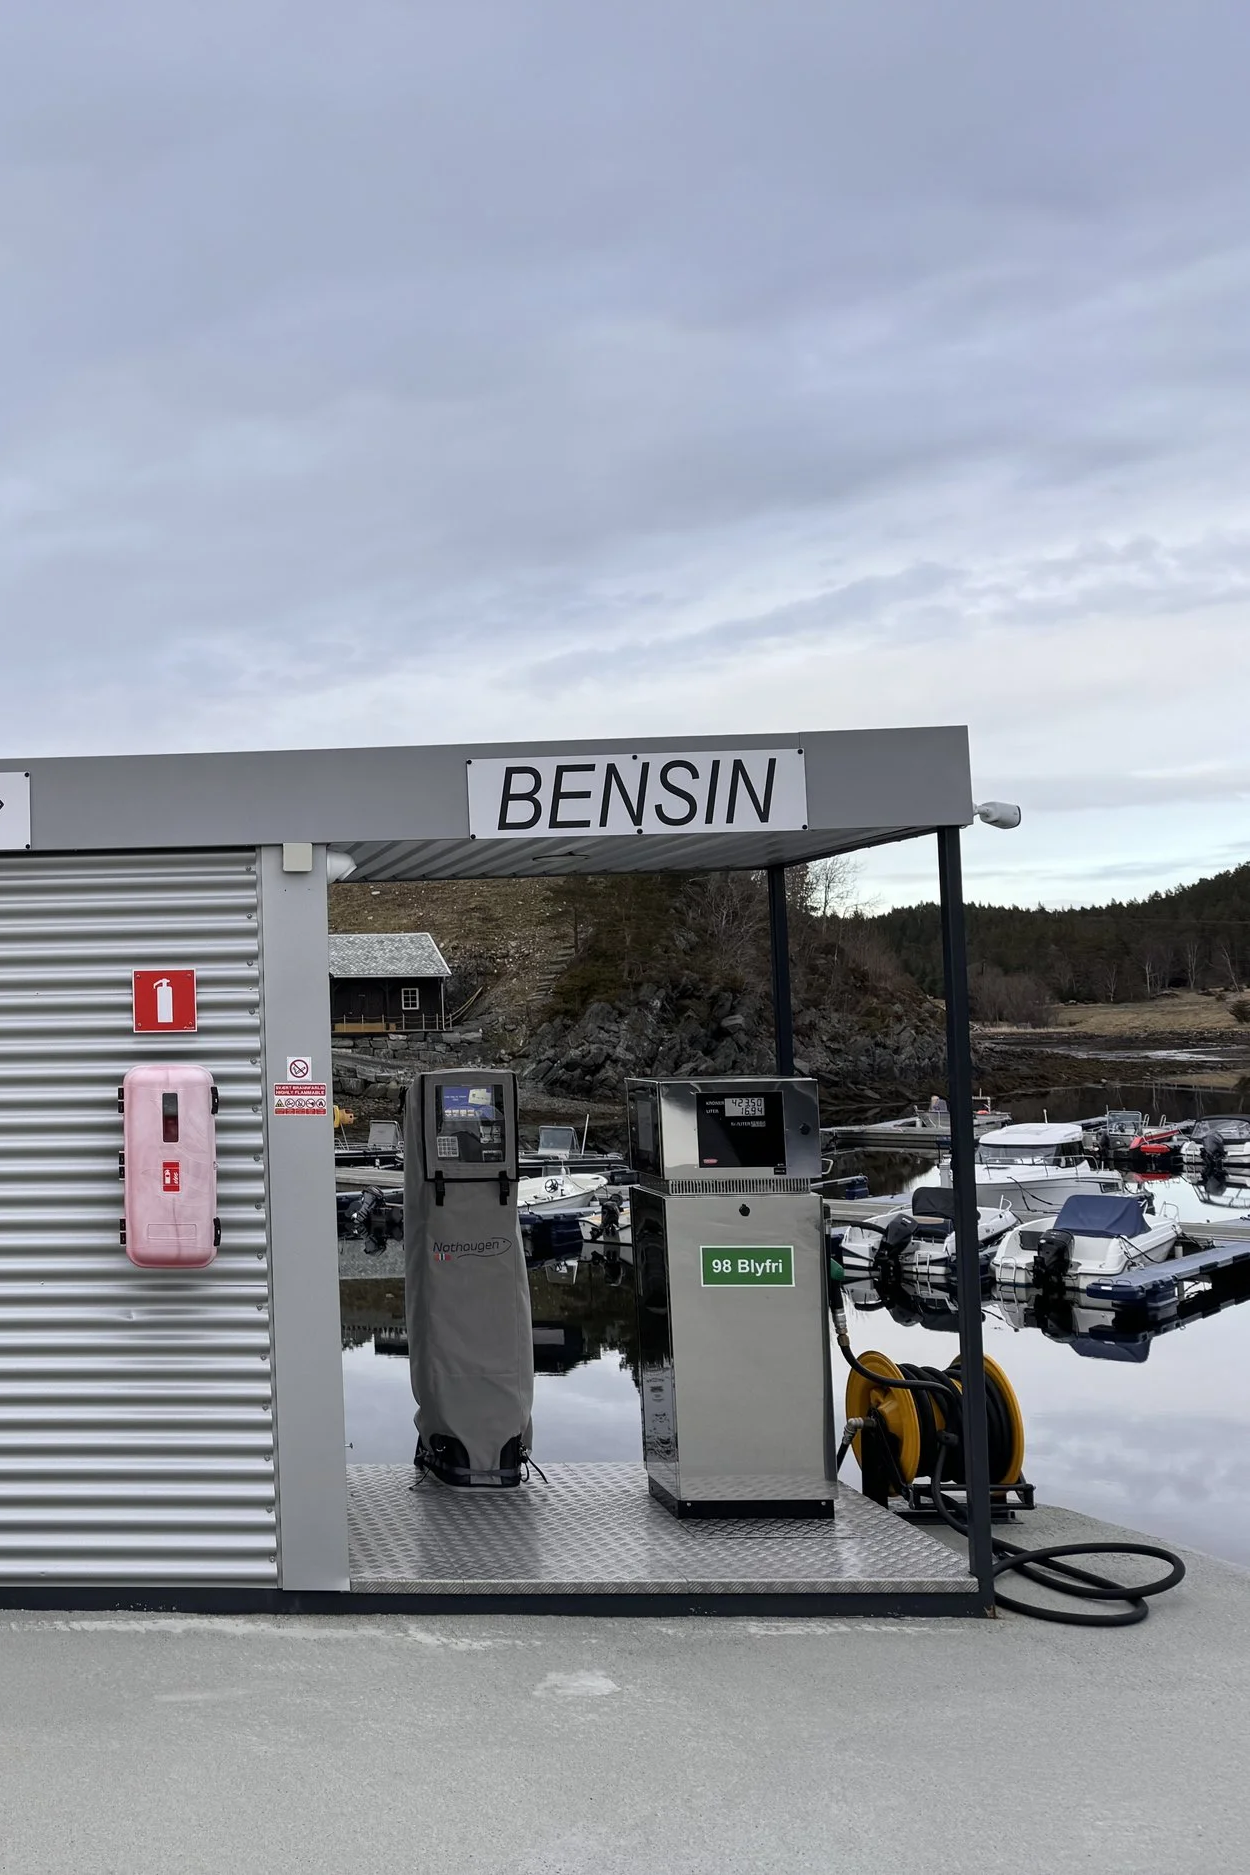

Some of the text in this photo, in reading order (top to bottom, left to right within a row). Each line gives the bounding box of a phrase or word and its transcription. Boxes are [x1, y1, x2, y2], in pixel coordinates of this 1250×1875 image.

[497, 757, 777, 830] BENSIN
[432, 1241, 500, 1253] Nothaugen
[711, 1259, 783, 1277] 98 Blyfri
